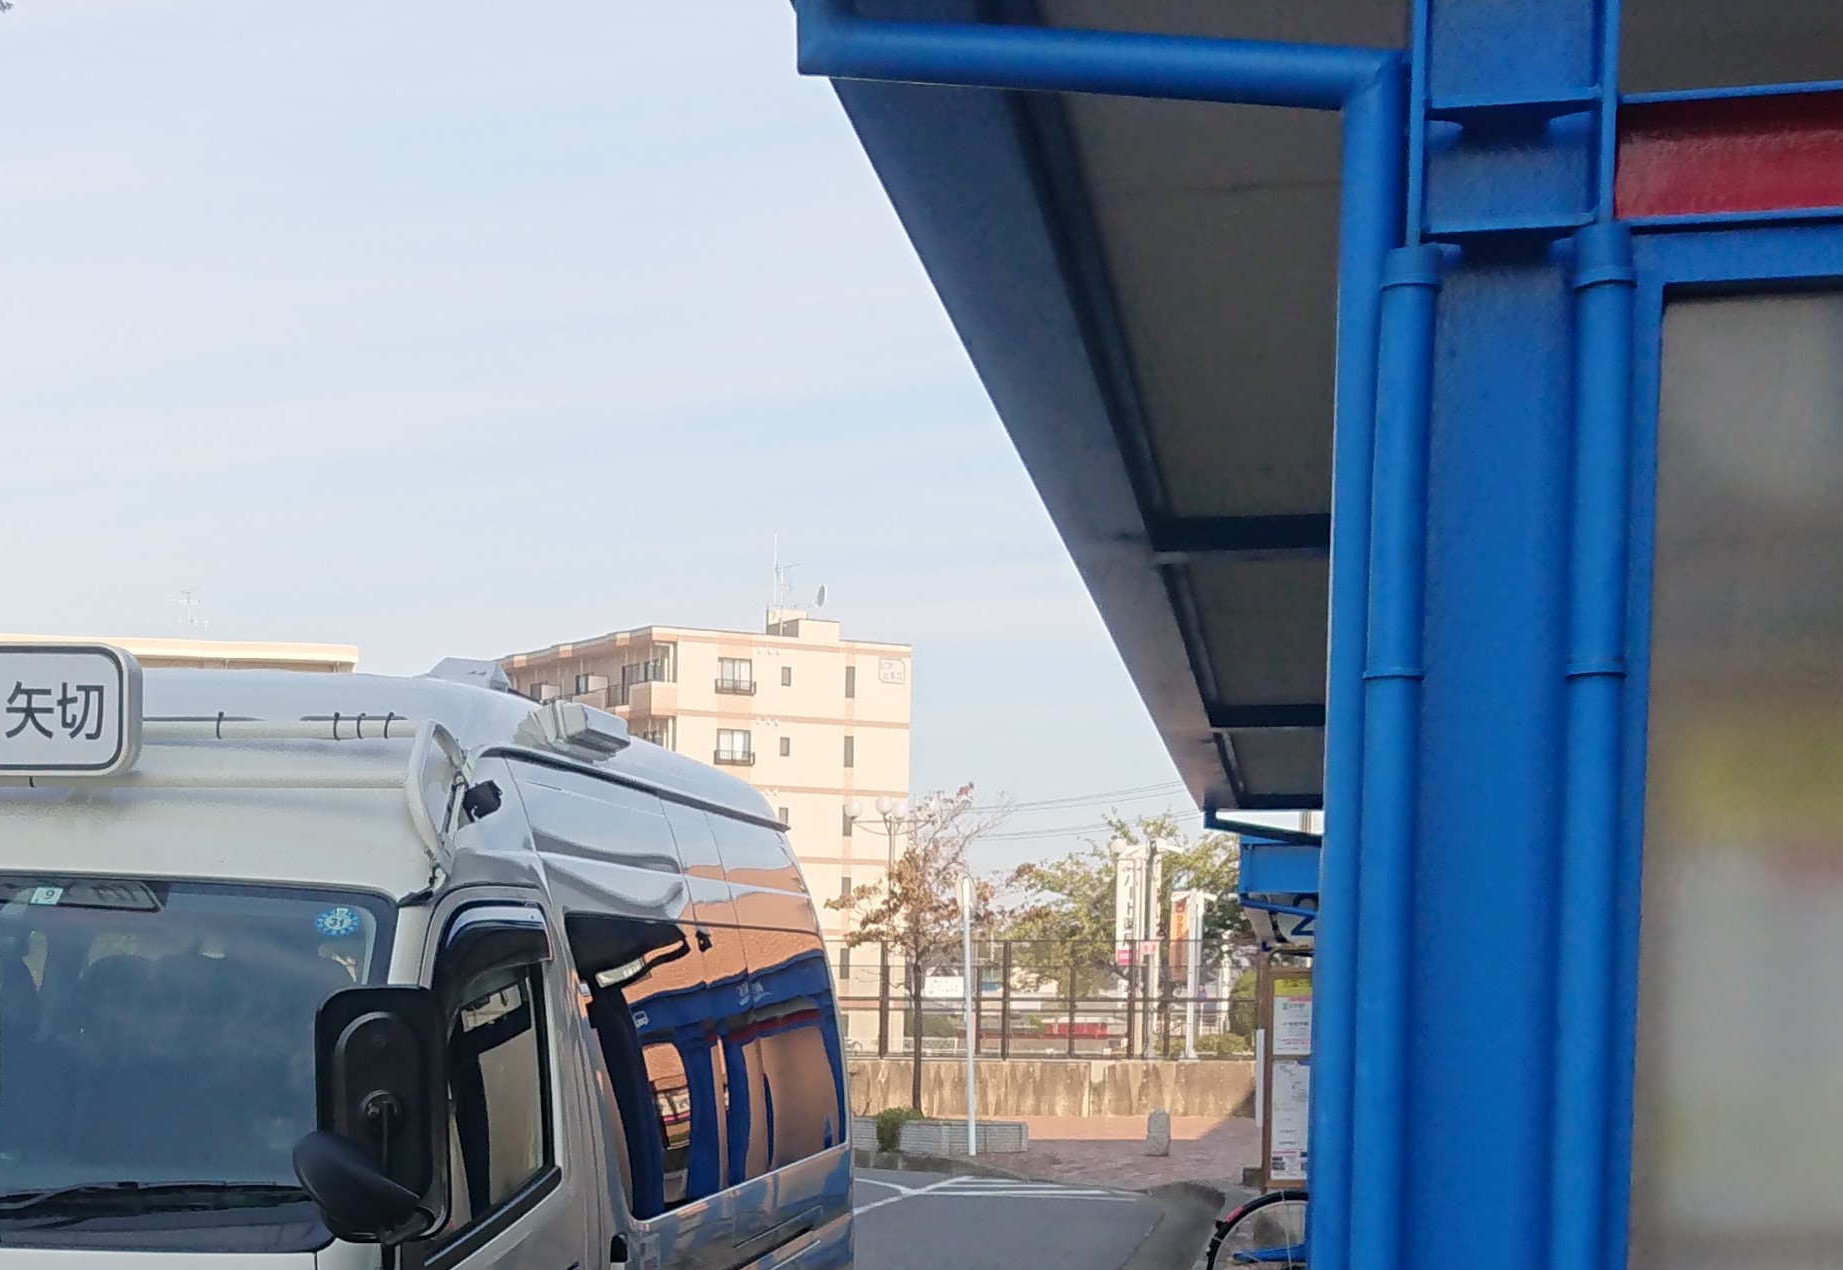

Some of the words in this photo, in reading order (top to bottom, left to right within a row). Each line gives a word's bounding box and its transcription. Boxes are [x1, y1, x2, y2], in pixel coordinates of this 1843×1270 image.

[4, 680, 106, 741] 矢切
[43, 889, 56, 900] 9
[329, 917, 345, 927] 31
